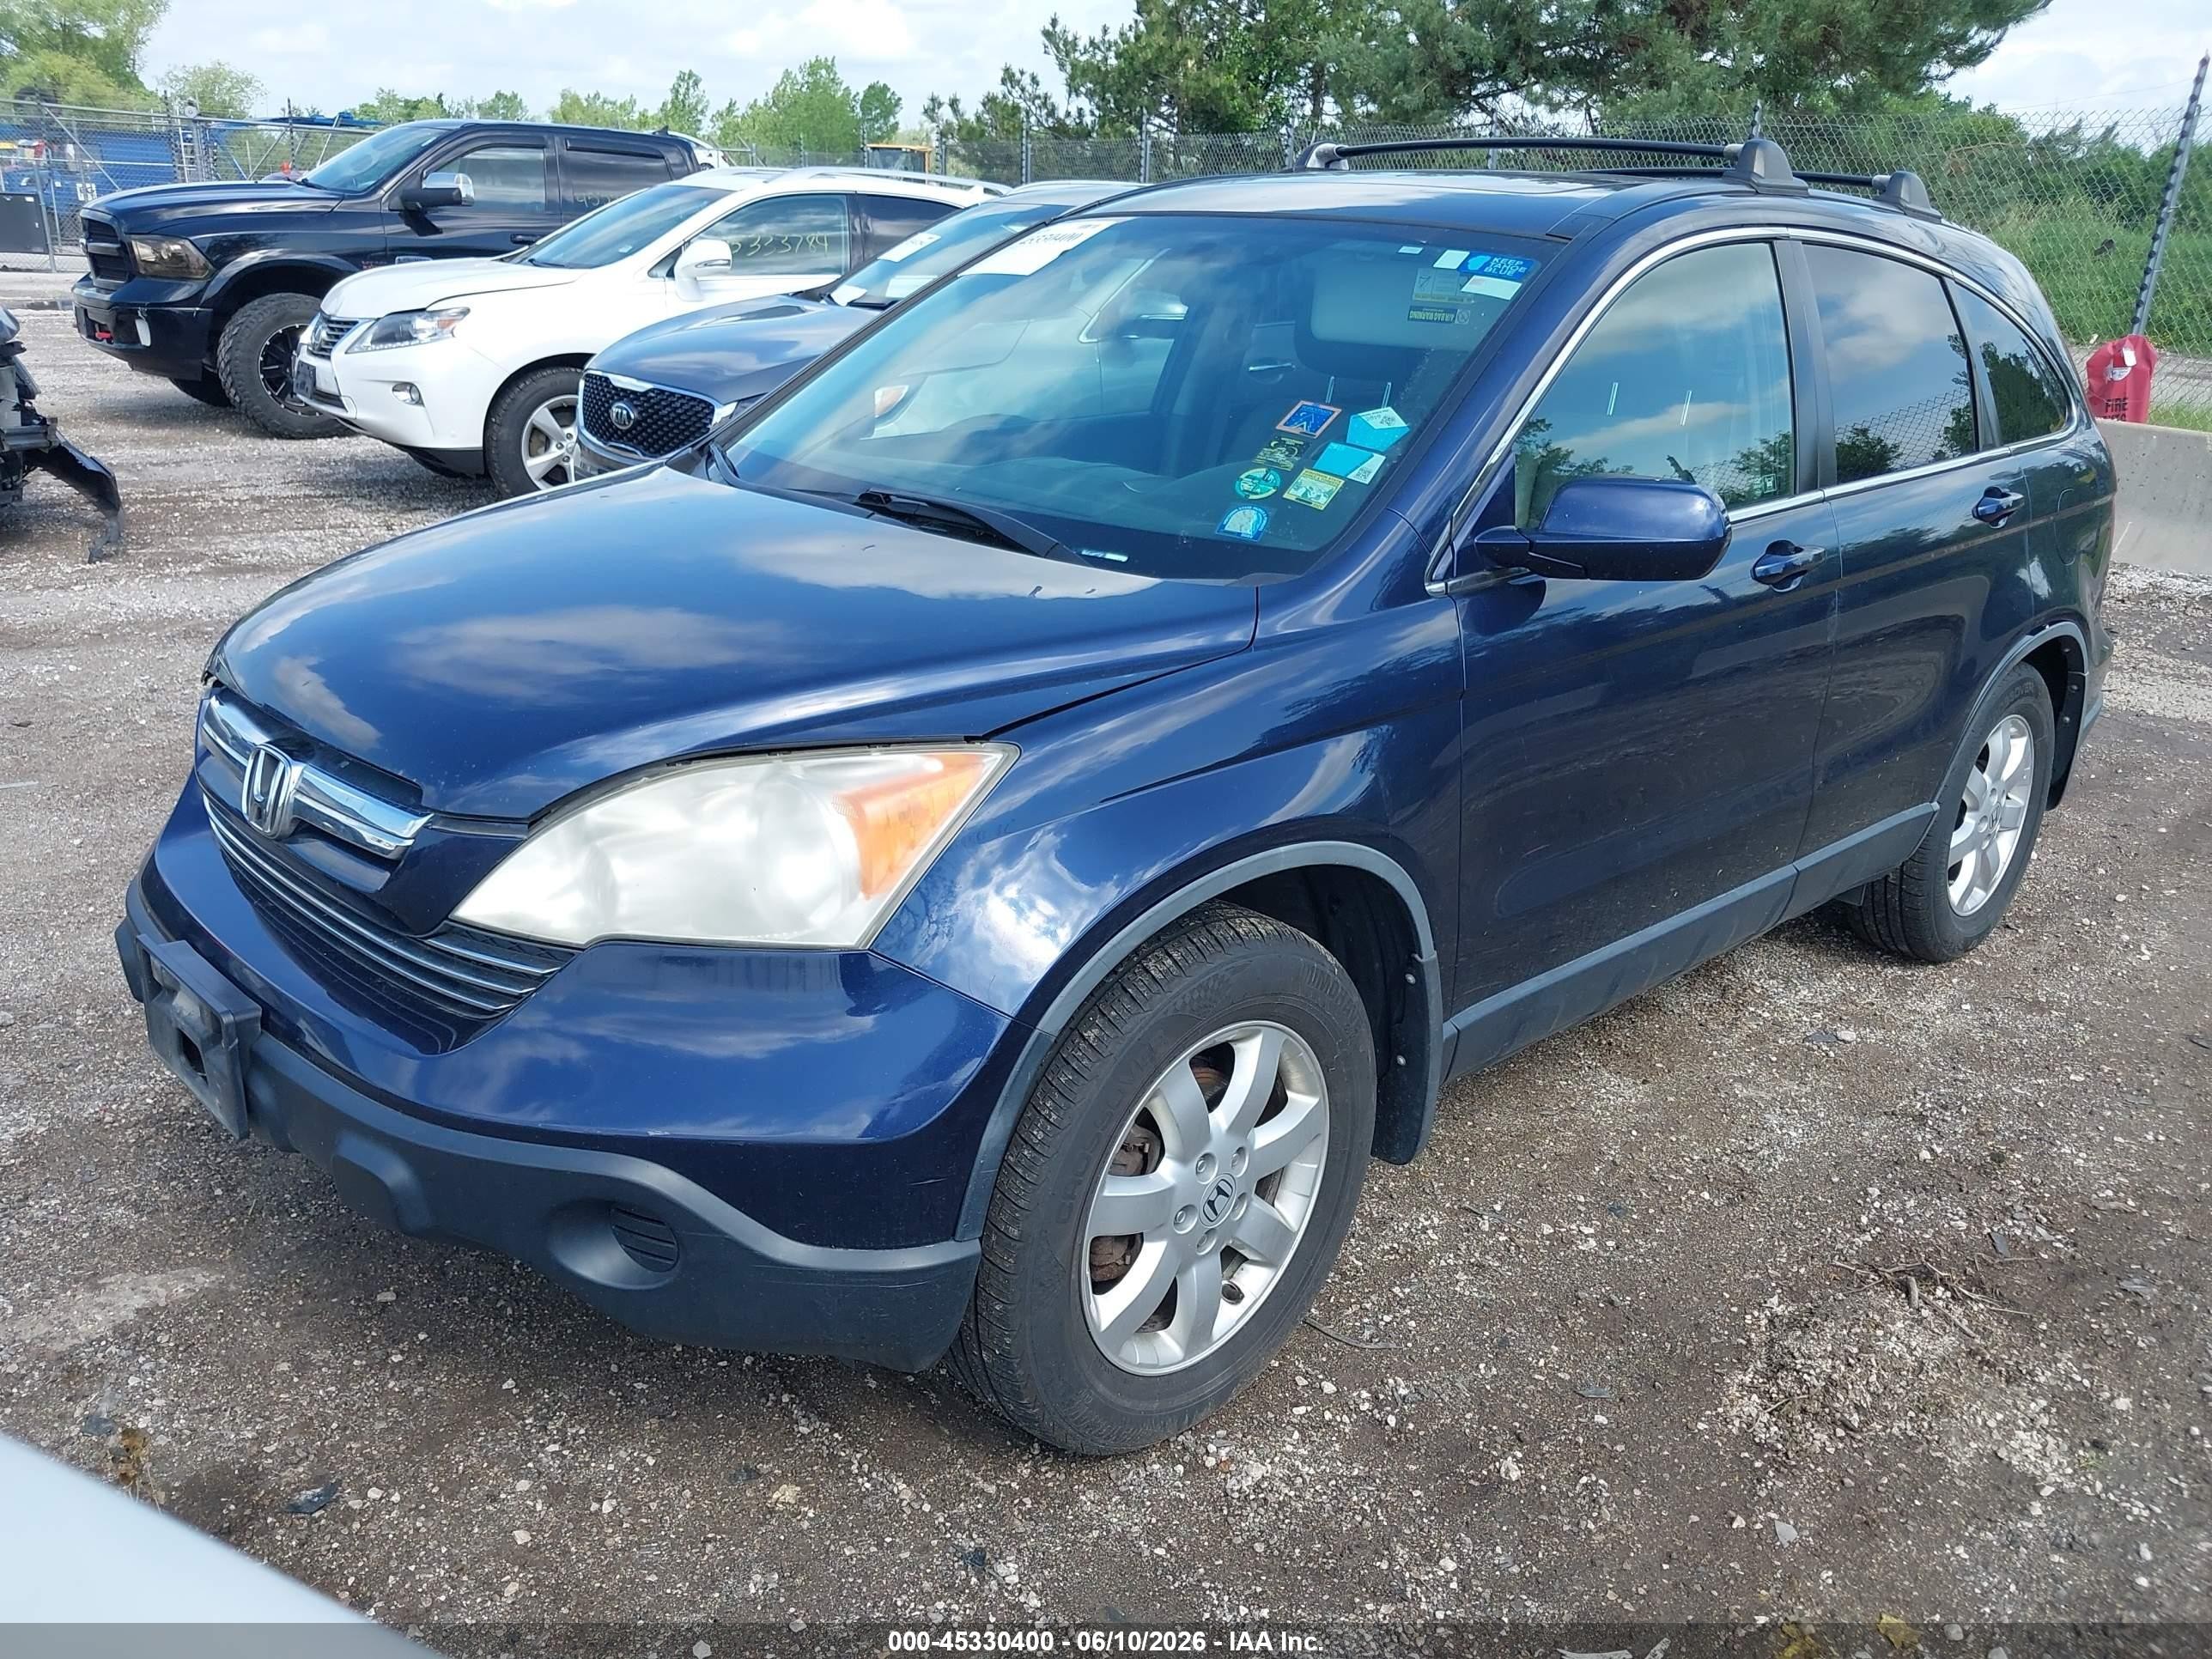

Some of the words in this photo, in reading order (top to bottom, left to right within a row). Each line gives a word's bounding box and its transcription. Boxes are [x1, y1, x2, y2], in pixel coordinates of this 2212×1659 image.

[1488, 261, 1528, 273] TAHOE
[1492, 257, 1524, 265] KEEP
[1483, 266, 1516, 276] BLUE
[2105, 398, 2128, 413] FIRE
[612, 408, 629, 425] KIA
